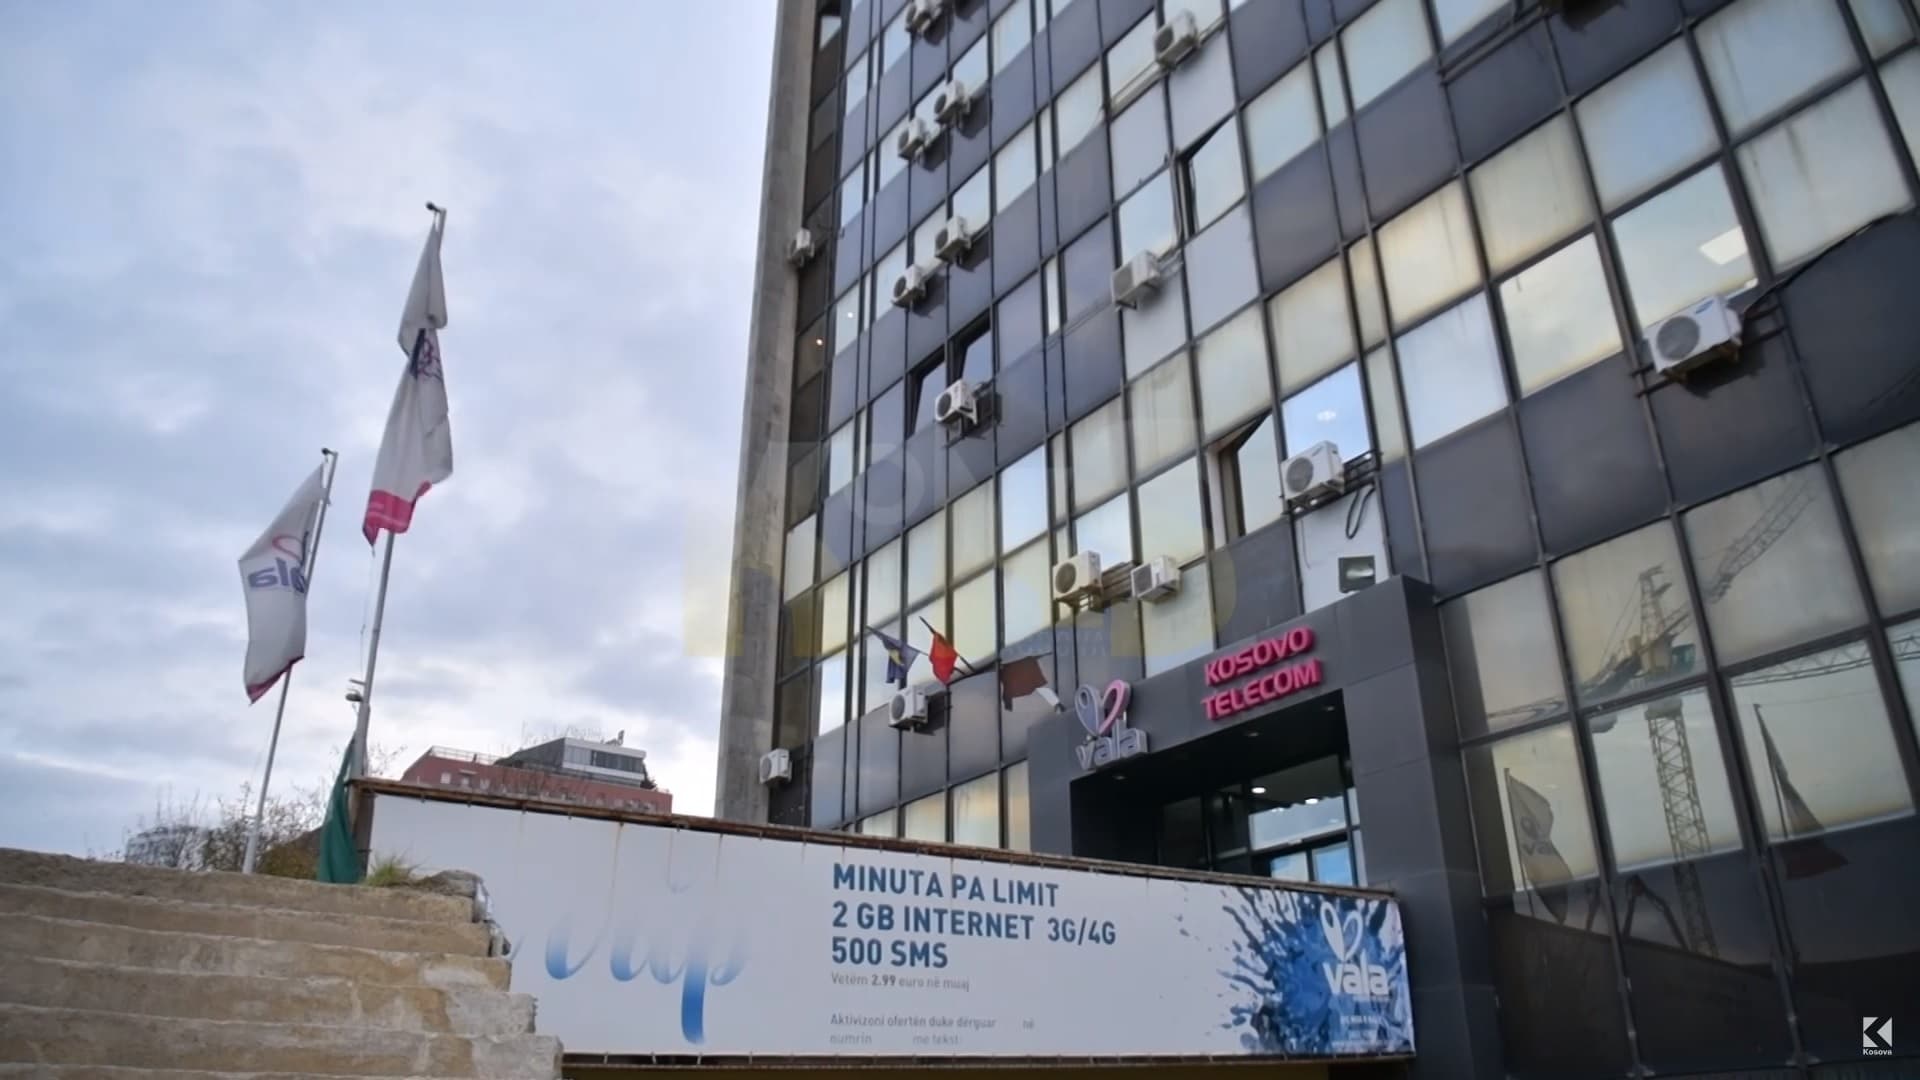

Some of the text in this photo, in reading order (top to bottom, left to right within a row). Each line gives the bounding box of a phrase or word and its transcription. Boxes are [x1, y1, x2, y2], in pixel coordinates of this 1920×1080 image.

[1203, 626, 1316, 688] KOSOVO
[1201, 658, 1323, 721] TELECOM
[1075, 710, 1149, 771] vala
[833, 863, 1059, 907] MINUTA PA LIMIT
[832, 900, 1117, 946] 2 GB INTERNET 3G/4G
[832, 936, 949, 969] 500 SMS
[1322, 948, 1390, 997] vala
[871, 974, 896, 987] 2.99
[898, 976, 924, 988] euro
[943, 978, 970, 993] muaj
[830, 1012, 885, 1027] Aktivizoni
[929, 1014, 954, 1028] duke
[912, 1034, 930, 1045] me
